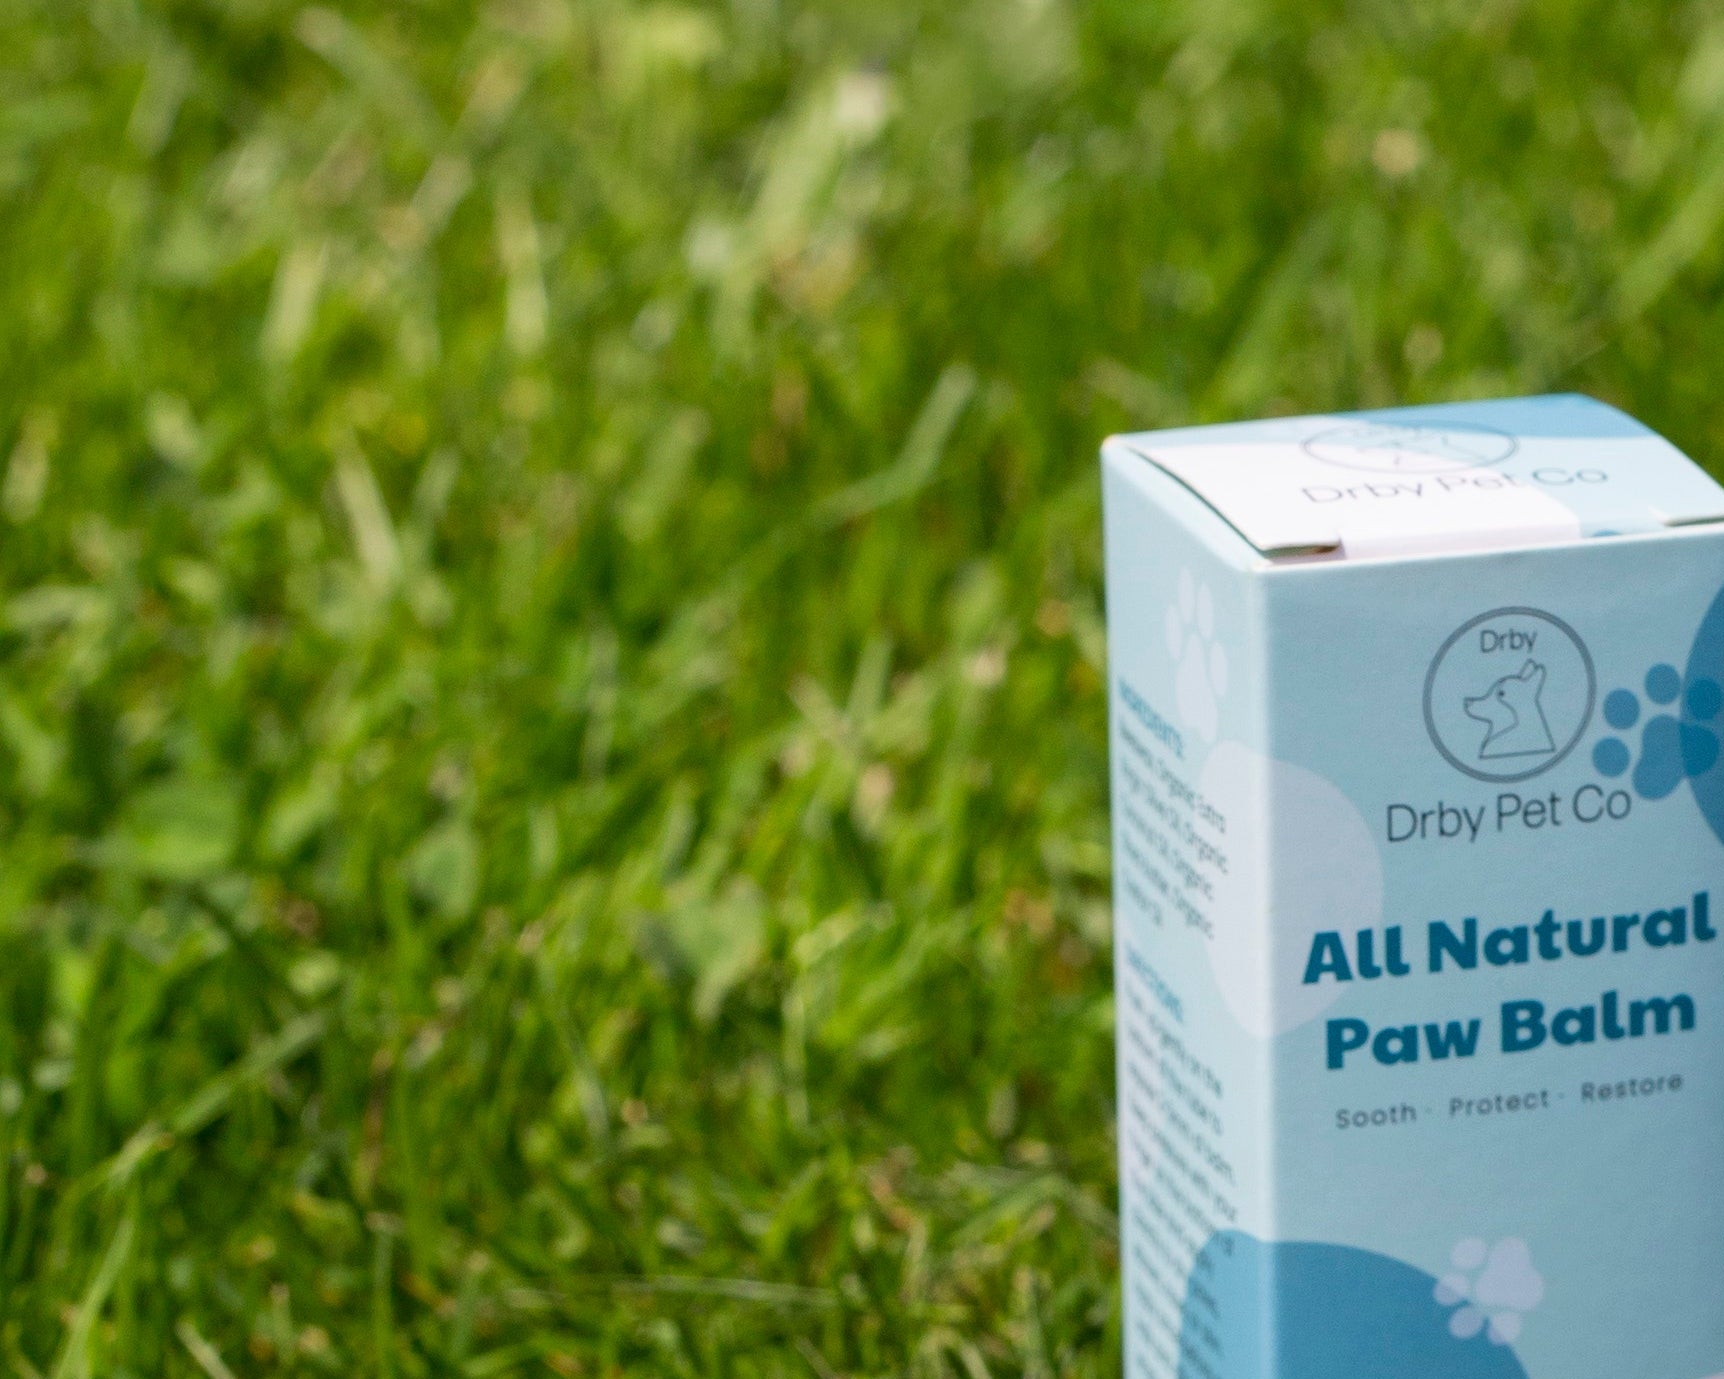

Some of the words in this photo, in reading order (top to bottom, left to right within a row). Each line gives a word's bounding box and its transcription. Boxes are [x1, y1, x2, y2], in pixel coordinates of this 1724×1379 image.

[1531, 467, 1609, 487] Co
[1479, 628, 1537, 654] Drby
[1386, 800, 1486, 843] Drby
[1496, 792, 1562, 832] Pet
[1571, 783, 1633, 824] Co
[1302, 925, 1410, 985] All
[1427, 891, 1718, 974] Natural
[1326, 1017, 1481, 1070] Paw
[1500, 990, 1696, 1054] Balm
[1335, 1102, 1418, 1131] Sooth
[1448, 1090, 1550, 1120] Protect
[1580, 1073, 1685, 1103] Restore
